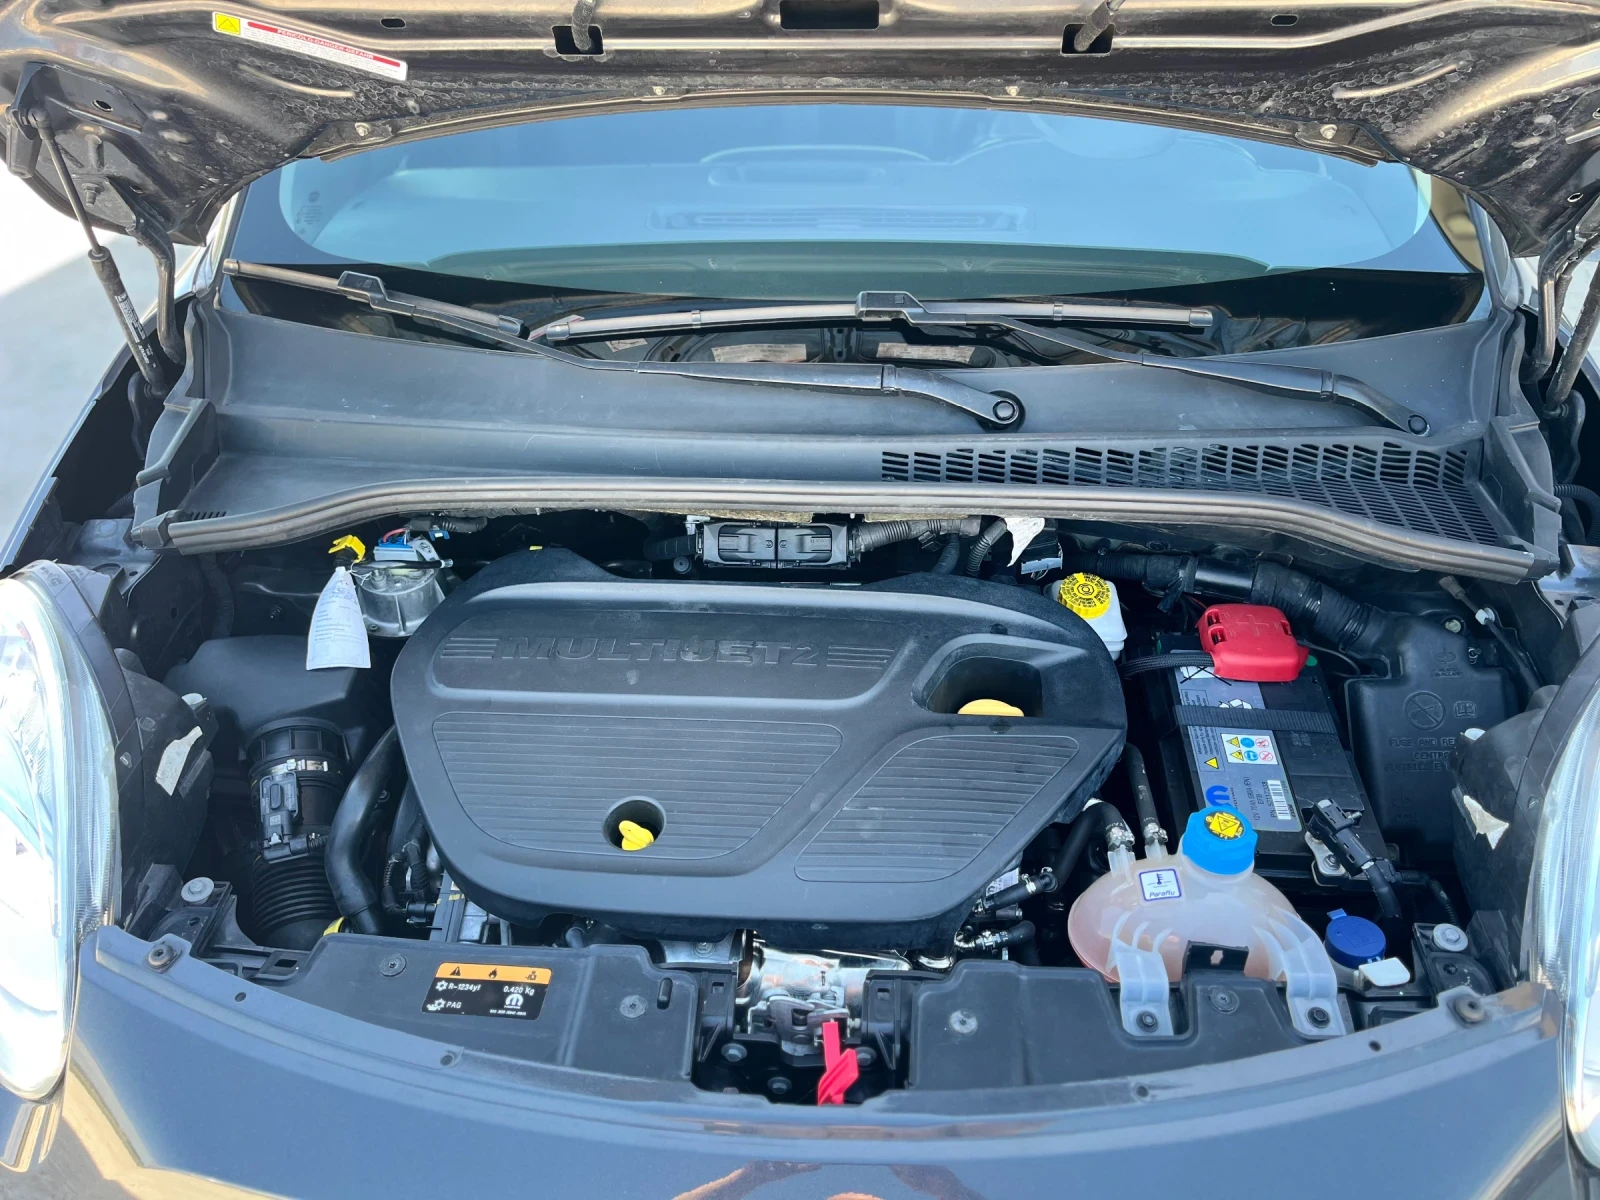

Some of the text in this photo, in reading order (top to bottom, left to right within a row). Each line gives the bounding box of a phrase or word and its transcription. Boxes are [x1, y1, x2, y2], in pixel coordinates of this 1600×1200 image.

[1389, 737, 1414, 747] FUSE
[1418, 738, 1437, 746] AND
[1149, 890, 1176, 898] Paraflu
[447, 983, 535, 996] R-1234yf 0.420 Kg
[446, 1001, 462, 1009] PAG
